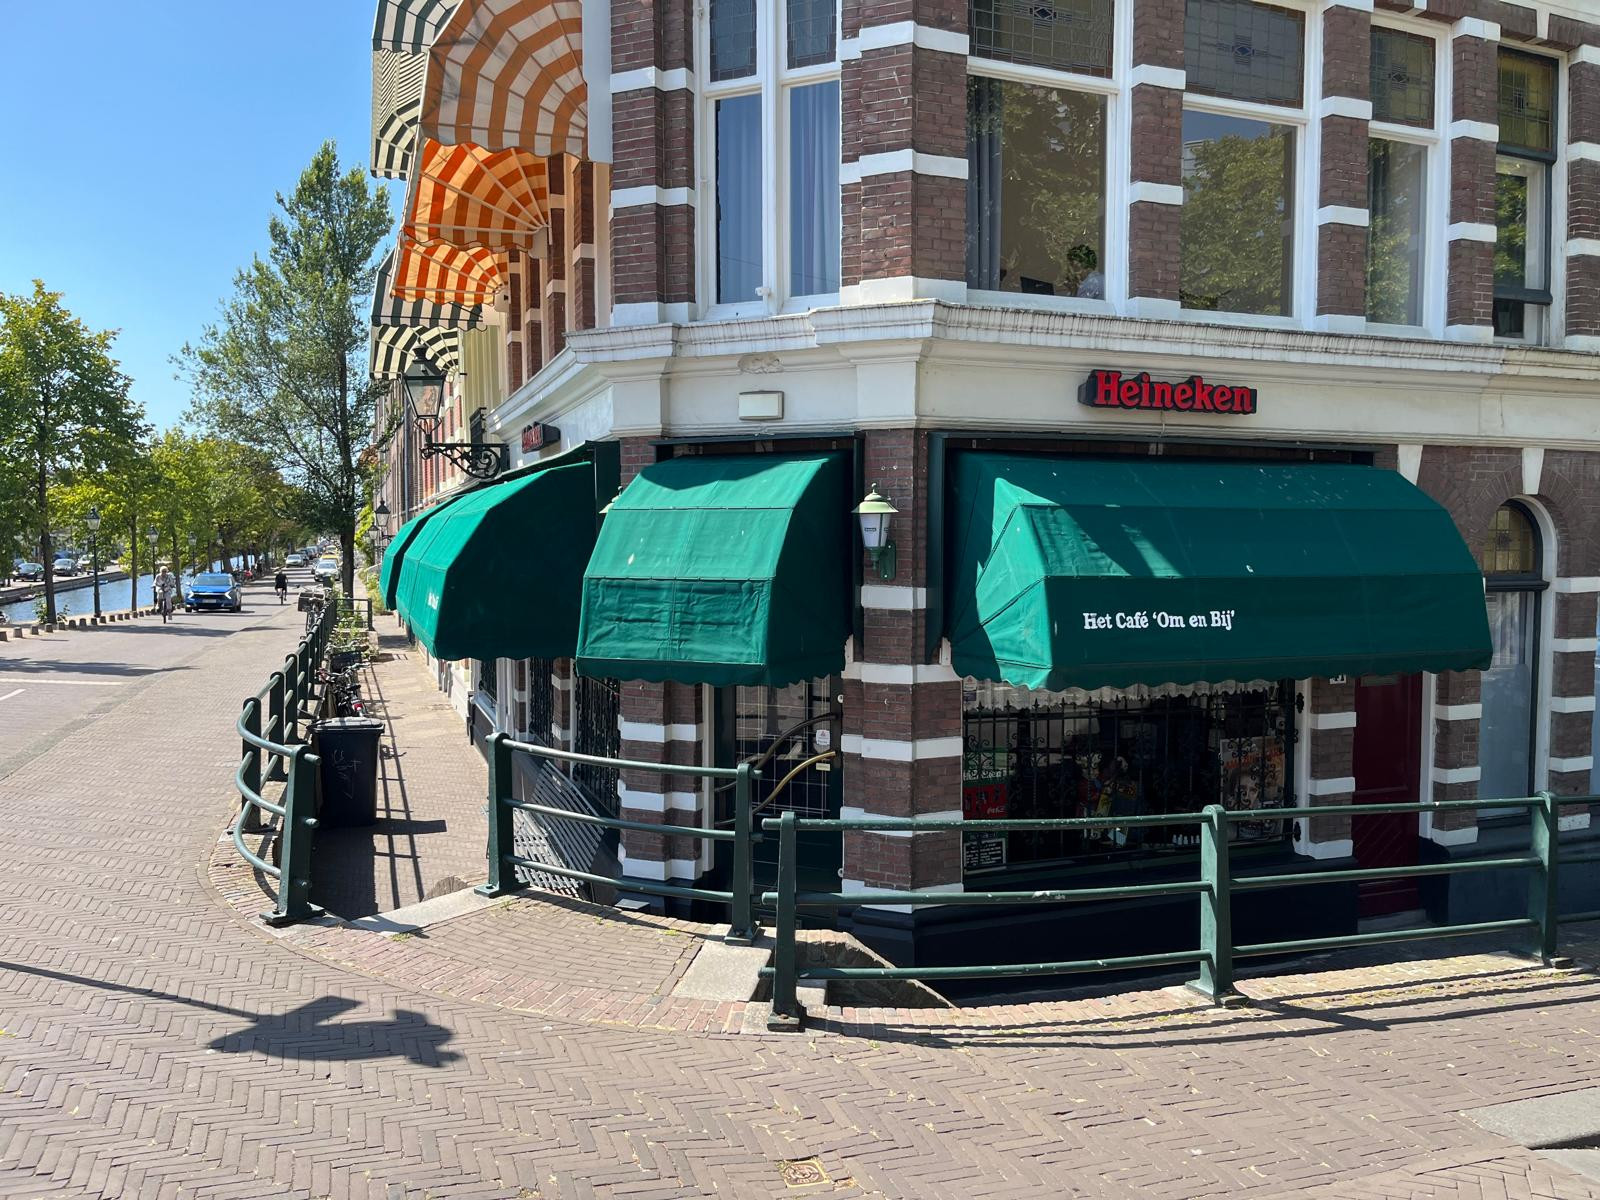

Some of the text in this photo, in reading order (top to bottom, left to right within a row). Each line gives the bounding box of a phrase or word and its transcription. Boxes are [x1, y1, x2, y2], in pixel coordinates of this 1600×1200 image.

[1094, 370, 1253, 413] Heineken
[1082, 612, 1113, 630] Het
[1115, 610, 1149, 629] Café
[1188, 615, 1208, 628] en
